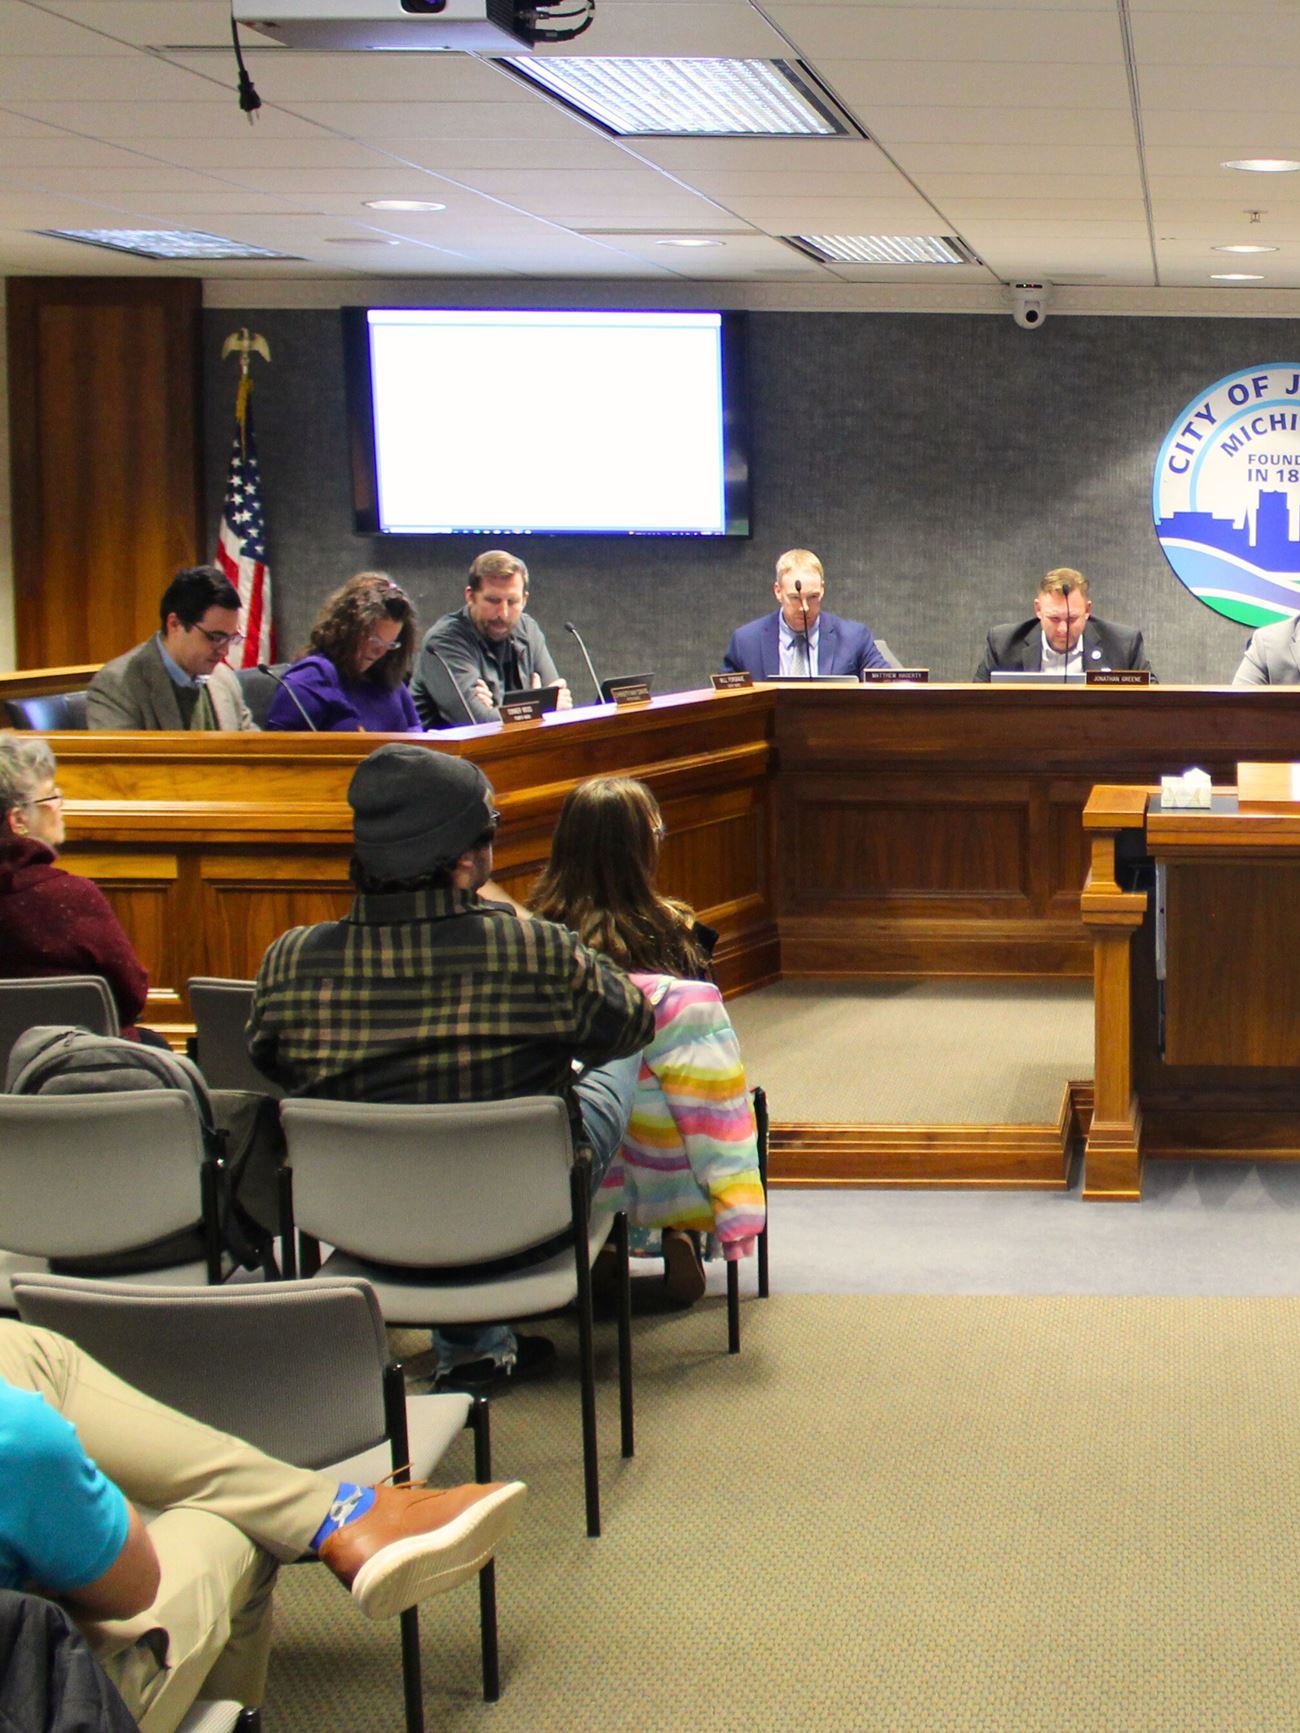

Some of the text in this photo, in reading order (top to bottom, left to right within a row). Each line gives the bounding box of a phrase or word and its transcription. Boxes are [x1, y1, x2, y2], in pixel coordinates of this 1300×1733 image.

[1168, 403, 1217, 475] CITY
[1227, 375, 1269, 406] OF
[1248, 469, 1268, 483] IN
